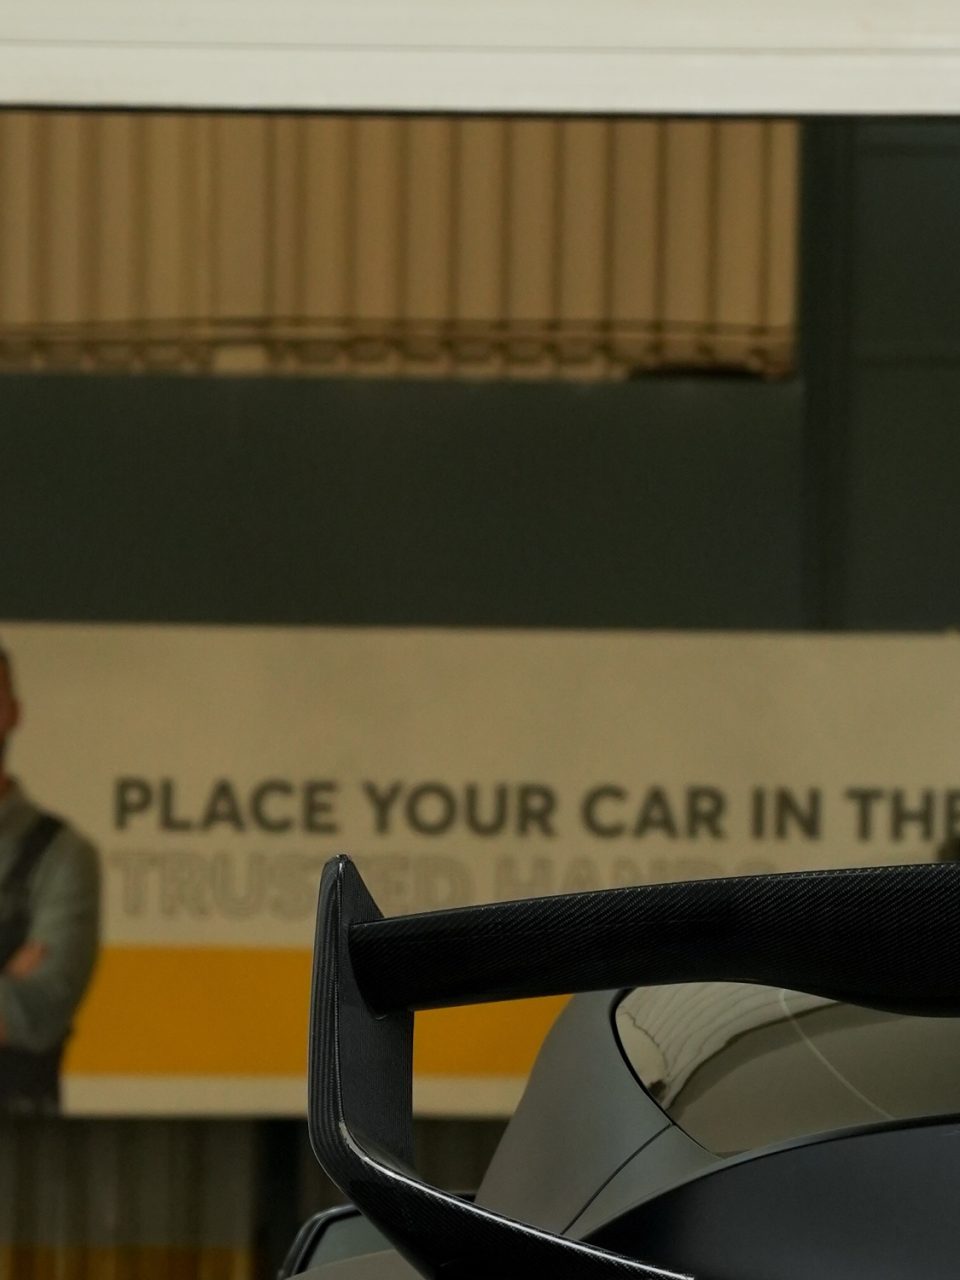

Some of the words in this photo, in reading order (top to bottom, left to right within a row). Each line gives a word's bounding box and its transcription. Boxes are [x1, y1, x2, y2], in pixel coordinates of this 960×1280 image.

[113, 777, 341, 834] PLACE
[363, 780, 558, 839] YOUR
[581, 784, 729, 840] CAR
[752, 785, 823, 841] IN
[109, 850, 476, 920] TRUSED
